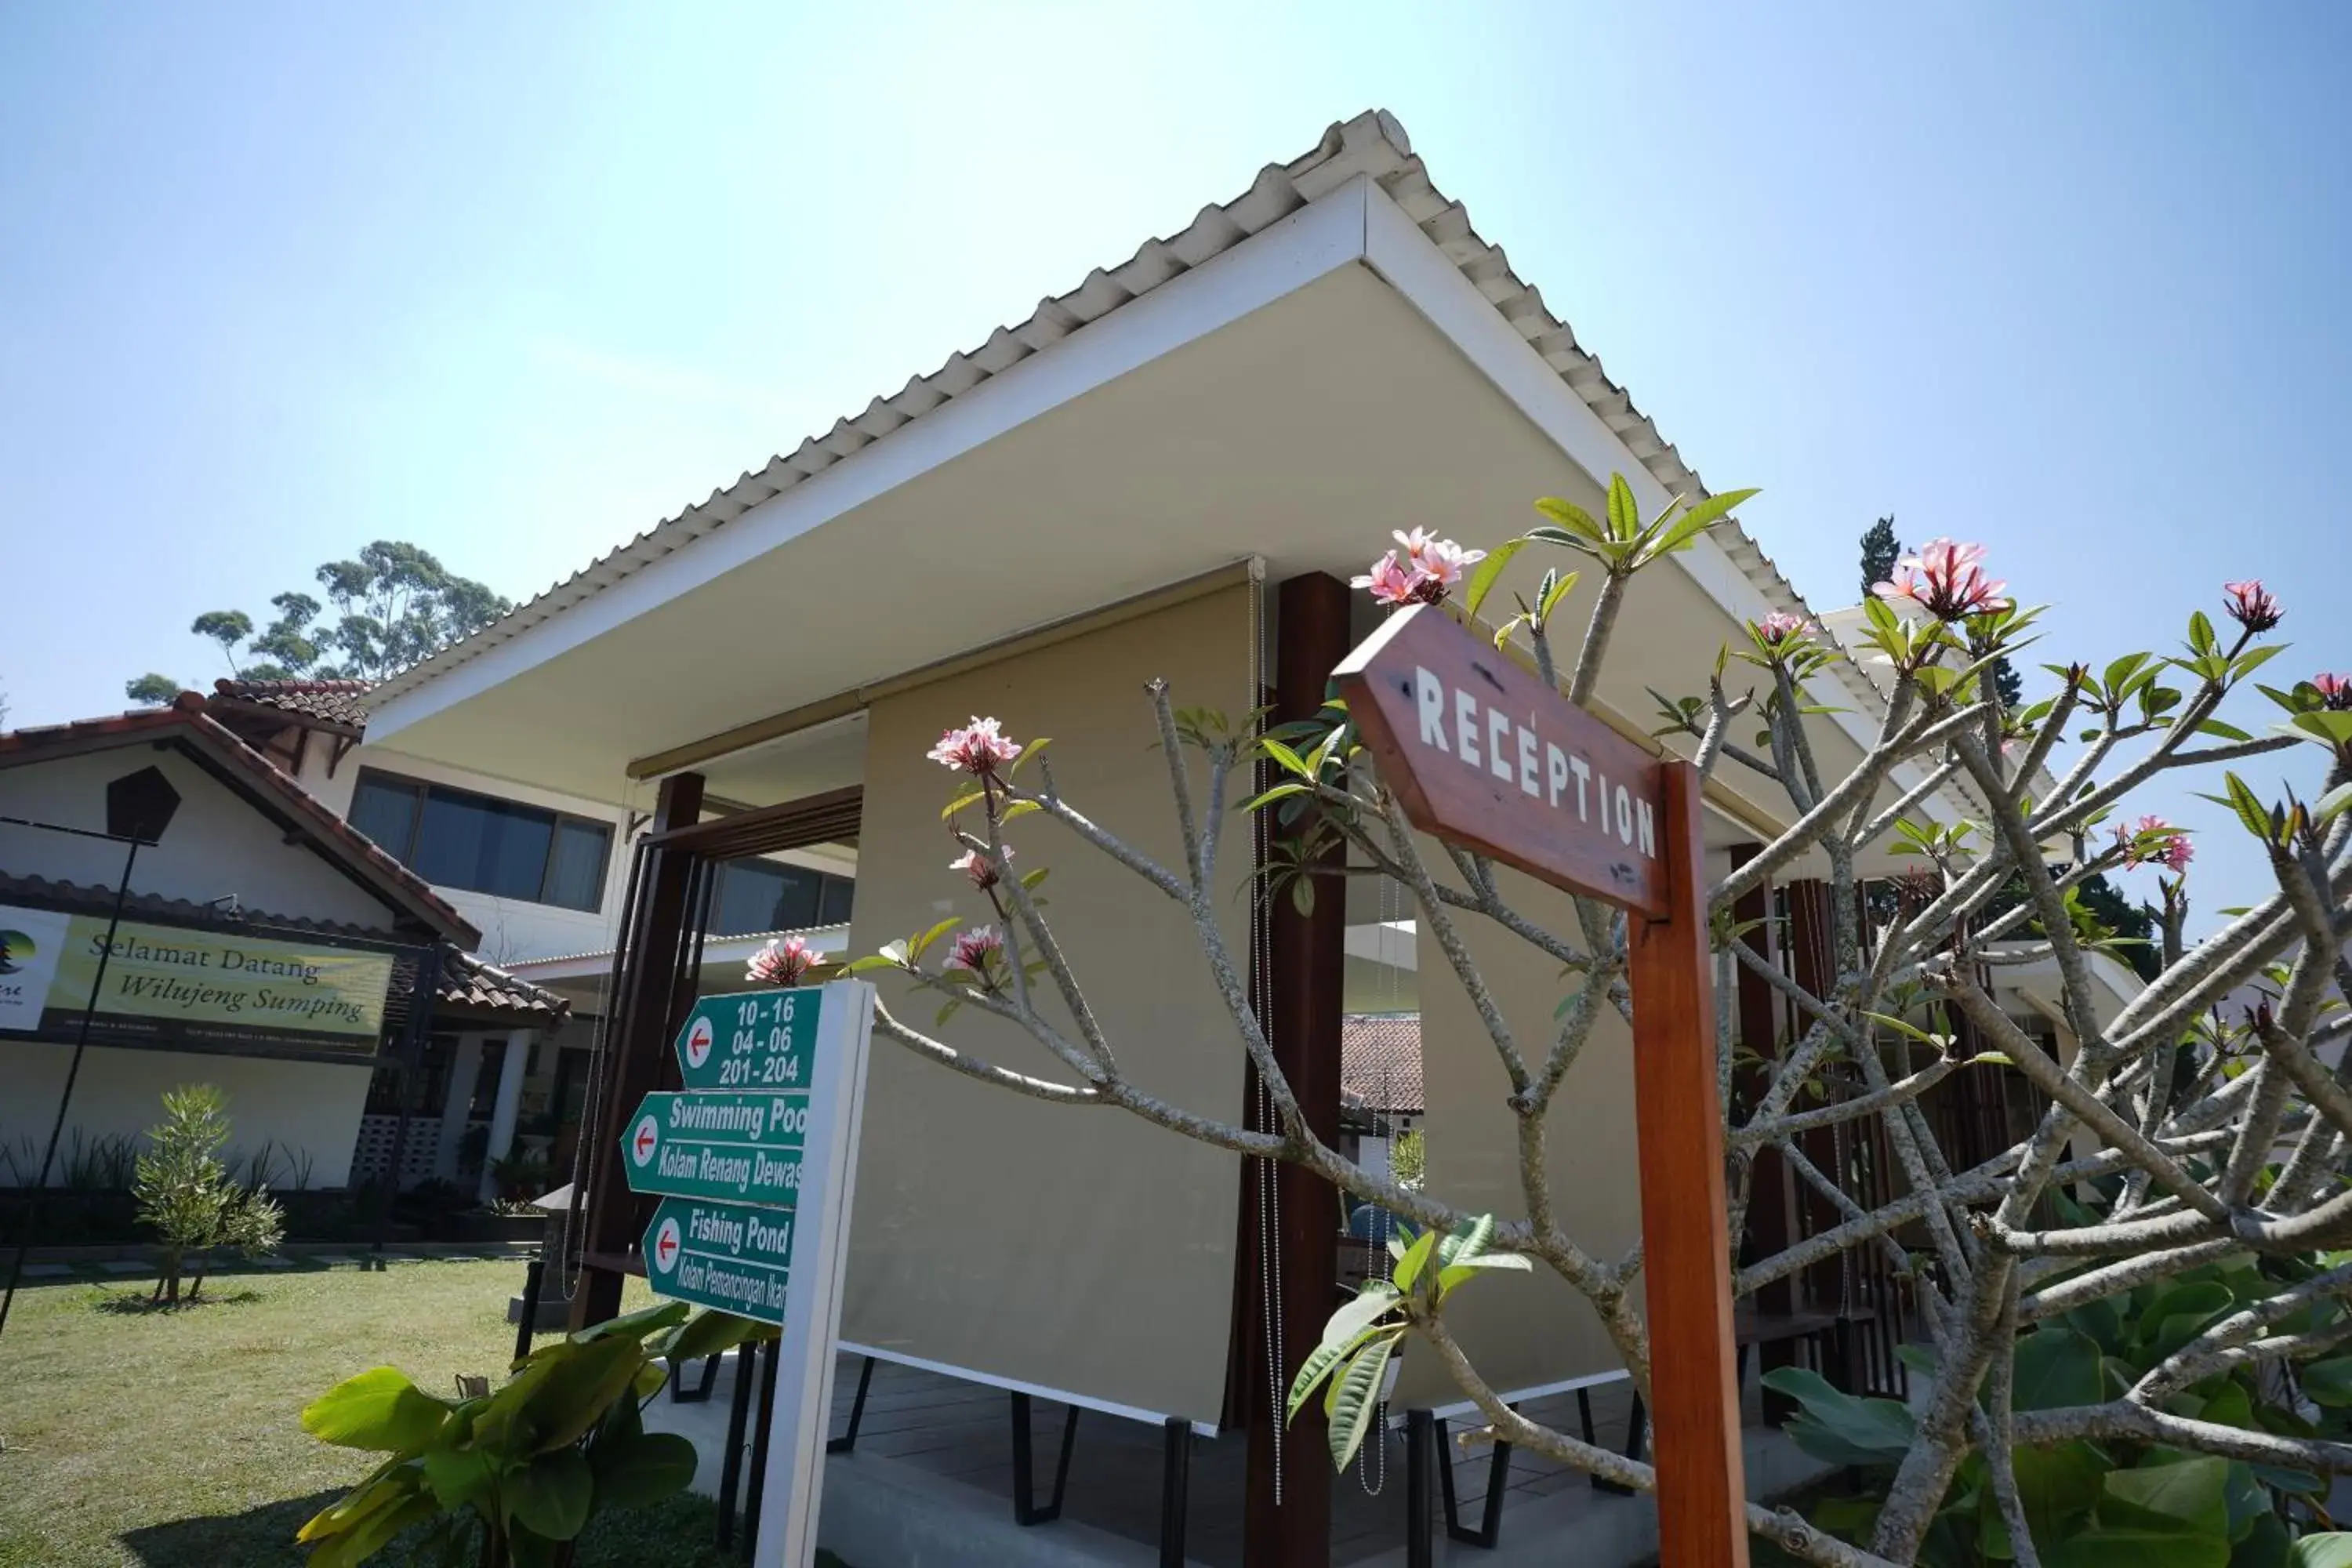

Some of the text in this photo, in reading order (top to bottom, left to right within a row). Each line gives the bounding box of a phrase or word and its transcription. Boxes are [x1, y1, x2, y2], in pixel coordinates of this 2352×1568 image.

[1416, 666, 1656, 859] RECEPTION
[89, 934, 321, 985] Selamat Datang
[119, 974, 365, 1023] Wilujeng Sumping
[669, 1098, 764, 1140] Swimming
[658, 1145, 697, 1179] Kolam
[699, 1148, 750, 1192] Renang
[689, 1208, 789, 1254] Fishing Pond
[677, 1256, 704, 1292] Kolam
[704, 1261, 766, 1311] Pemancingan
